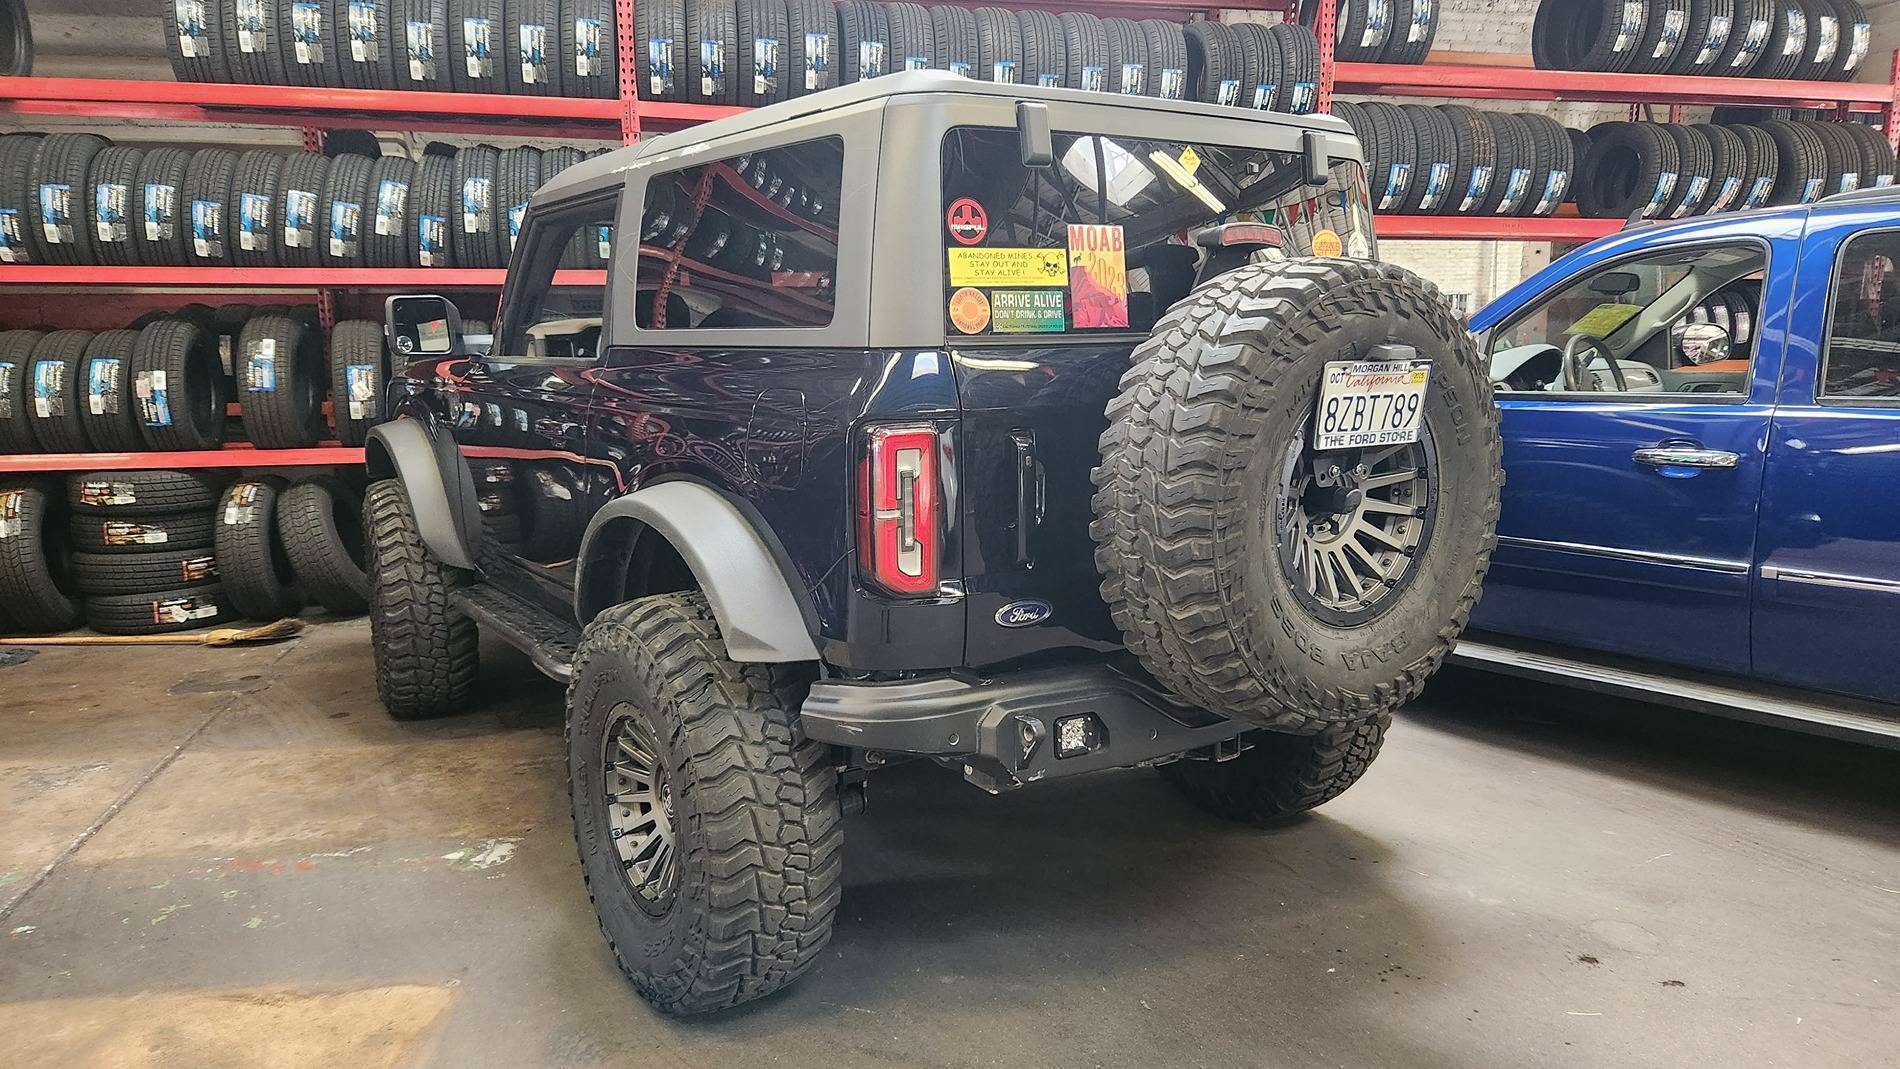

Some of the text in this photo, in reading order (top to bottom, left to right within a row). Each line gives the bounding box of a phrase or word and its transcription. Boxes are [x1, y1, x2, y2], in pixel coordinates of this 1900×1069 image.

[1069, 225, 1122, 252] MOAB
[957, 252, 1033, 260] ABANDONED MINES
[970, 260, 990, 268] STAY
[974, 269, 996, 277] STAY
[994, 293, 1062, 308] ARRIVE ALIVE
[995, 310, 1062, 319] DON'T DRINK & DRIVE
[1352, 363, 1410, 373] MORGAN HILL
[1330, 372, 1345, 384] OCT
[1345, 374, 1411, 392] California
[1324, 393, 1419, 434] 8ZBT789
[1324, 431, 1413, 447] THE FORD STORE
[1009, 607, 1039, 623] Ford
[1270, 594, 1410, 672] BAJA BOSS
